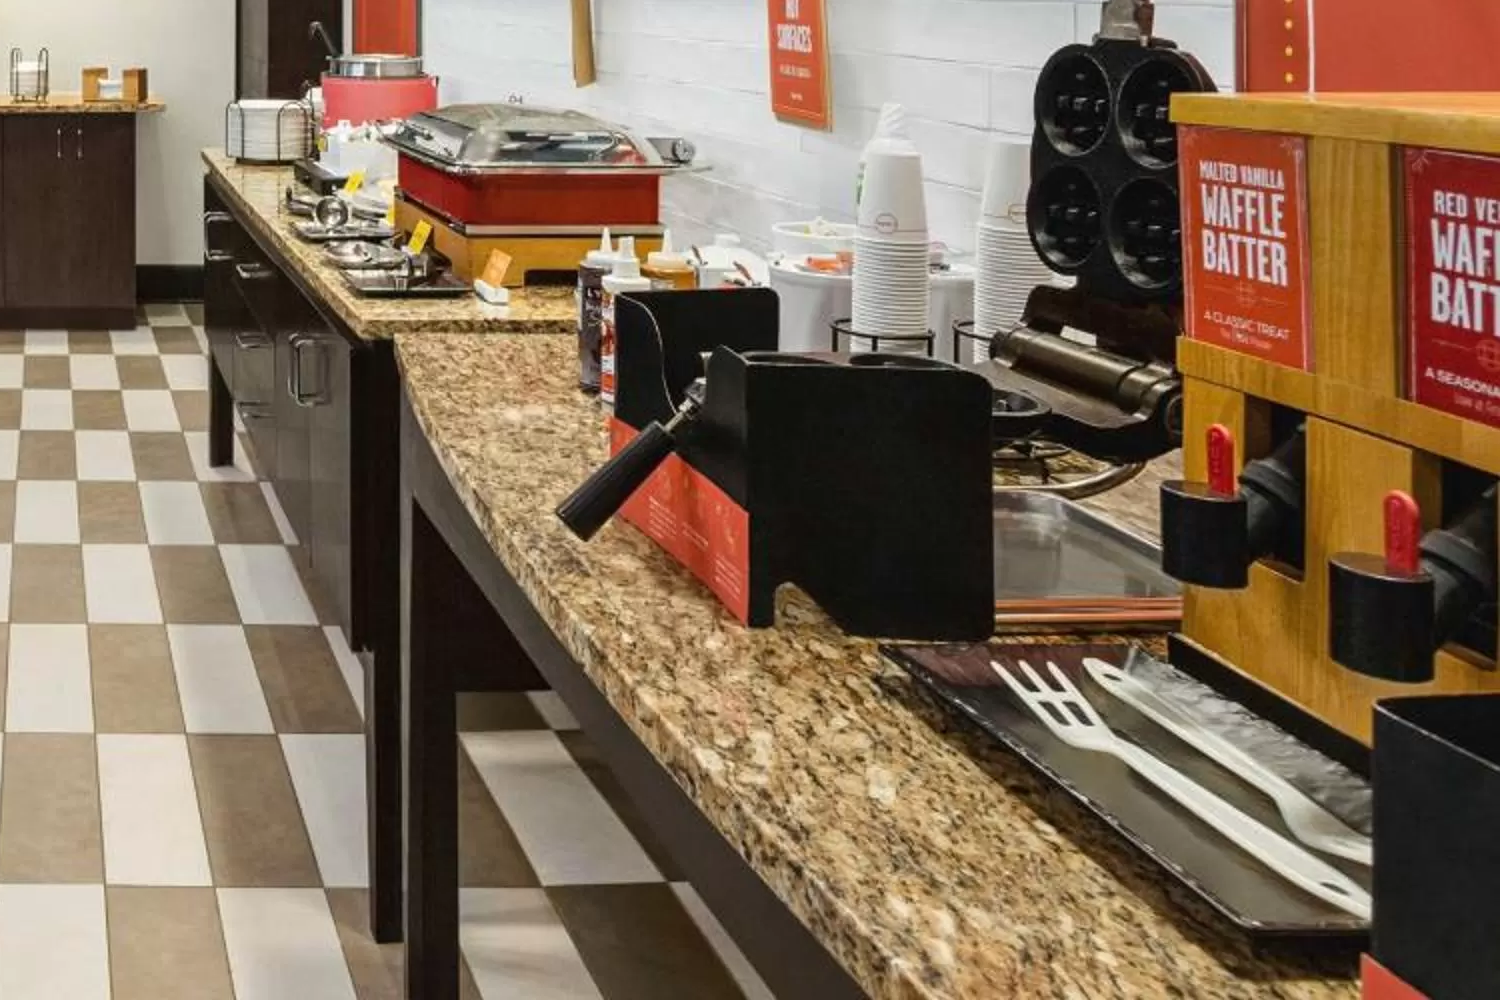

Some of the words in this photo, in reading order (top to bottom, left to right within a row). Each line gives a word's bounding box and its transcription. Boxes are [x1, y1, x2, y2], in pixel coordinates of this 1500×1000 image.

[1198, 160, 1237, 183] MALTED
[1240, 164, 1284, 190] VANILLA
[1200, 183, 1287, 239] WAFFLE
[1433, 190, 1468, 219] RED
[1474, 196, 1500, 224] VE
[1202, 227, 1288, 288] BATTER
[1212, 310, 1256, 333] CLASSIC
[1255, 320, 1290, 340] TREAT
[1424, 367, 1434, 379] A
